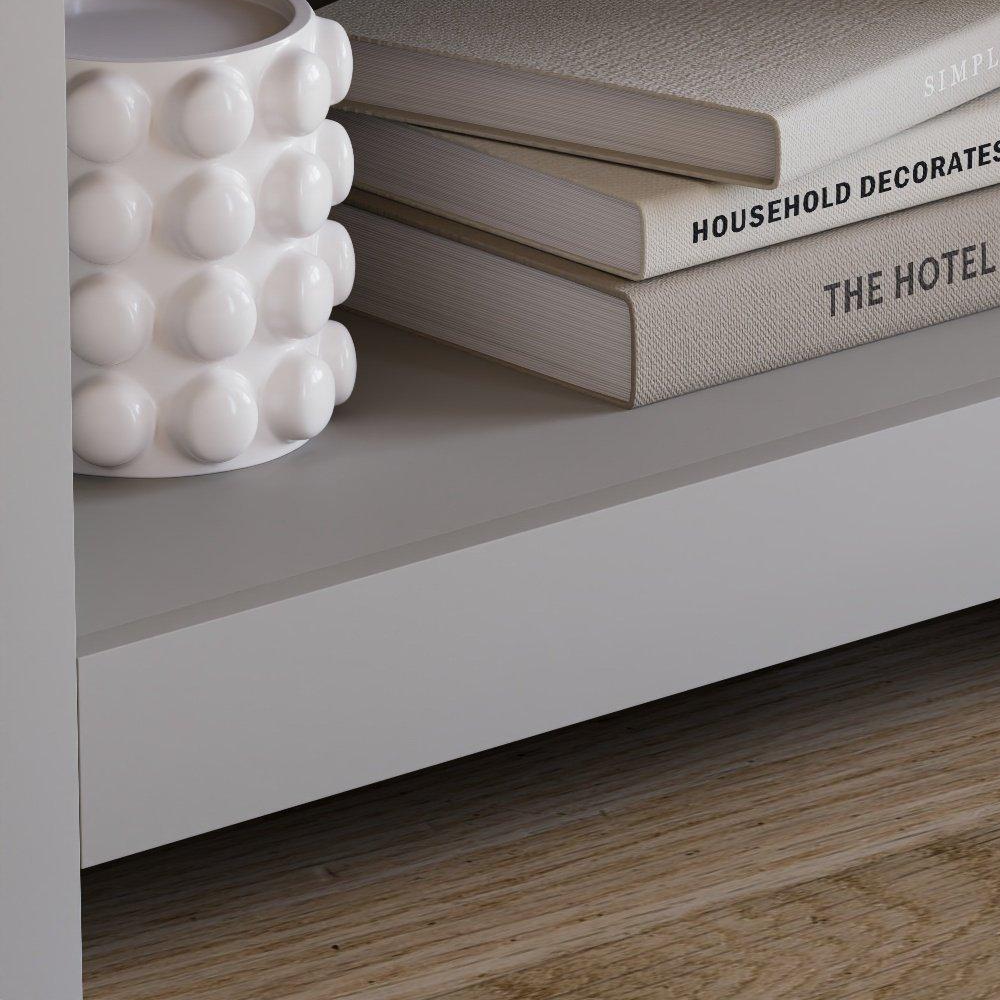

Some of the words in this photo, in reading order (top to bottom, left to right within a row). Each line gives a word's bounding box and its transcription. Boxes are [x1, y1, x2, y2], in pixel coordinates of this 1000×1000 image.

[691, 182, 851, 244] HOUSEHOLD
[823, 270, 884, 317] THE
[894, 244, 996, 300] HOTEL
